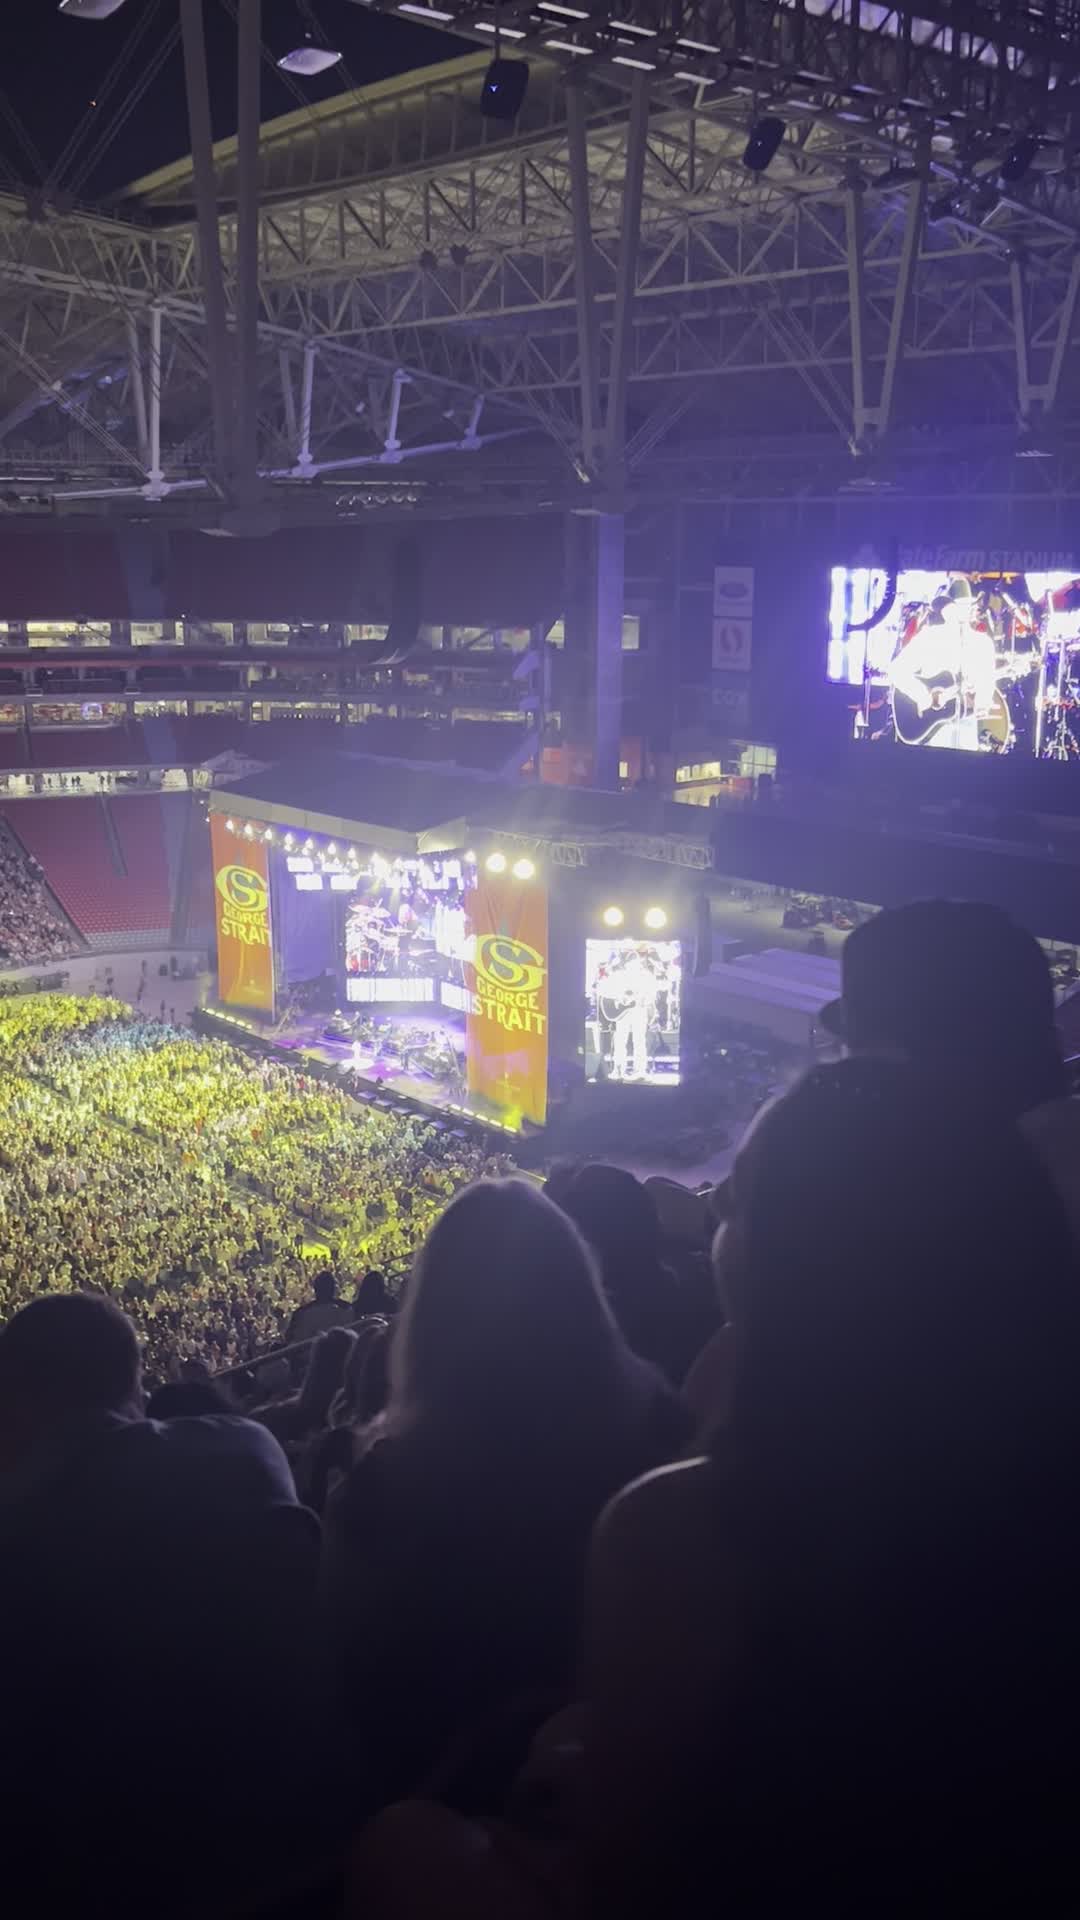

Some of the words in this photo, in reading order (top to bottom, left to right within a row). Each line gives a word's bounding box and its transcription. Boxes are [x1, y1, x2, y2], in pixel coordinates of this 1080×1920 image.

[990, 549, 1074, 571] STADIUM
[223, 900, 268, 929] GEORGE
[476, 976, 540, 1010] GEORGE
[472, 994, 546, 1035] STRAIT
